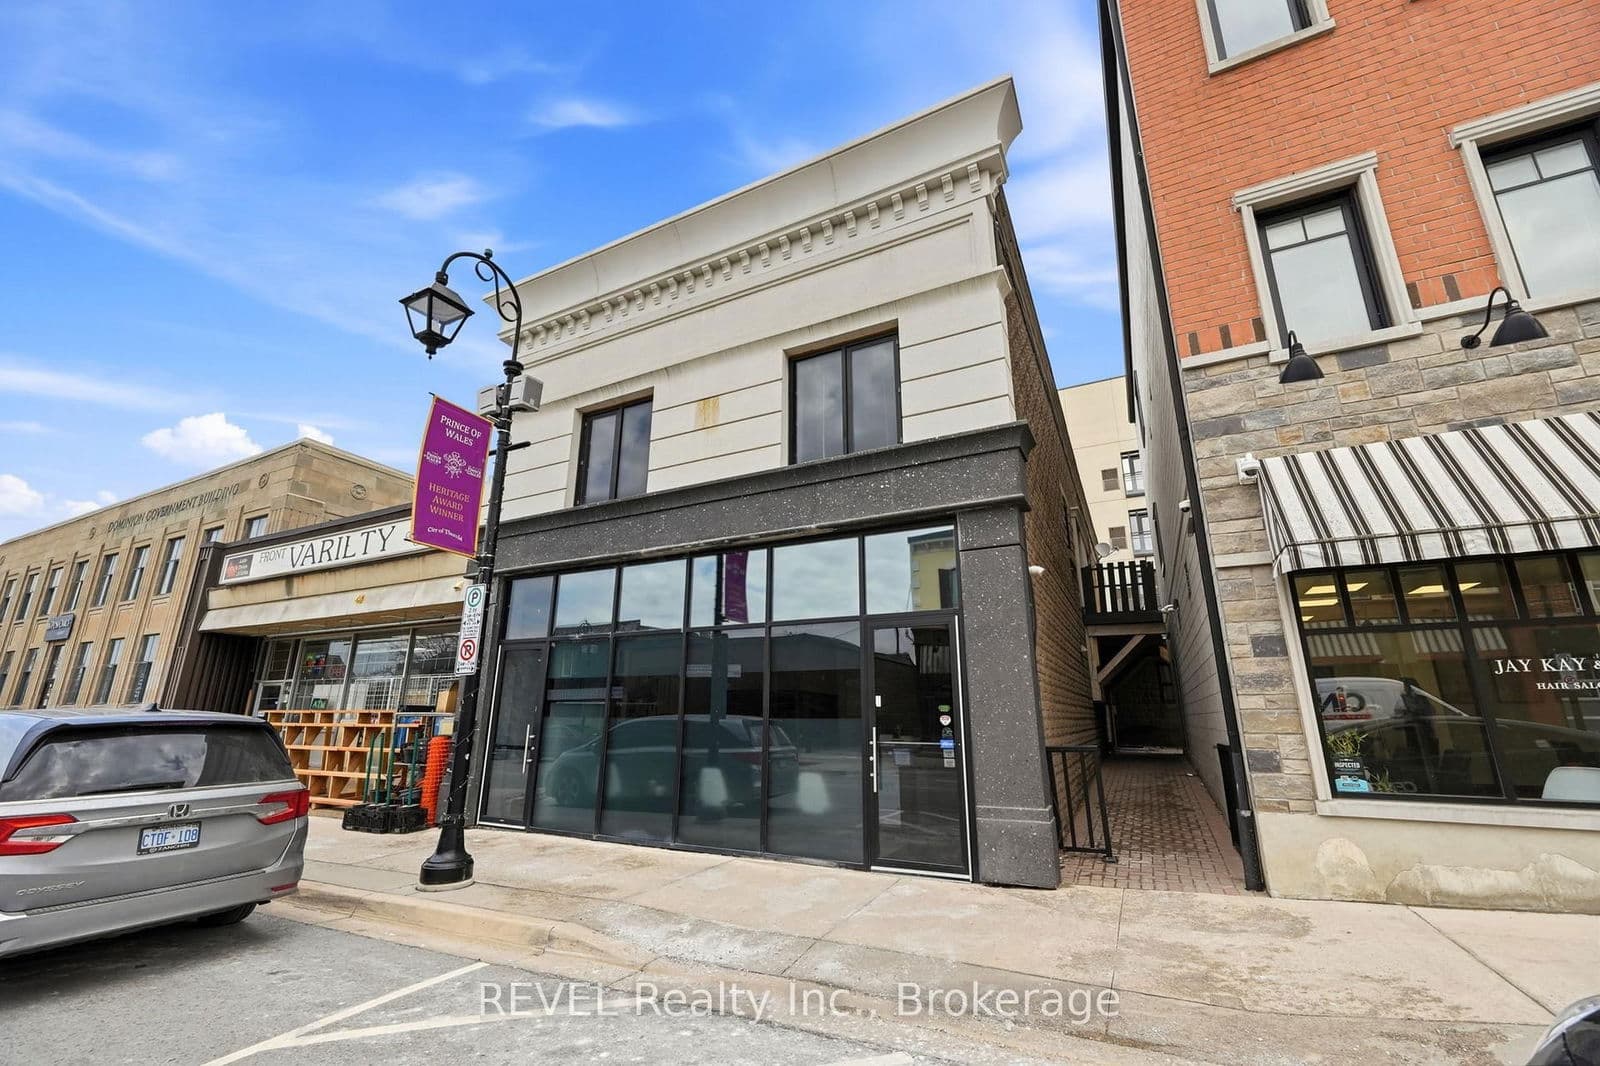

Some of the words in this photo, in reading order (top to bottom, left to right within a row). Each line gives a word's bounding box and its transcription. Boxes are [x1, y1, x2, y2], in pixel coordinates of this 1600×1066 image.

[440, 414, 471, 434] PRINCE
[470, 428, 482, 439] OF
[445, 428, 474, 447] WALES
[429, 482, 470, 503] HERITAGE
[107, 513, 147, 533] DOMINION
[146, 496, 199, 521] GOVERNMENT
[198, 483, 240, 507] BUILDING
[432, 495, 464, 511] AWARD
[430, 504, 464, 522] WINNER
[259, 547, 288, 563] FRONT
[1494, 659, 1532, 675] JAY
[1540, 657, 1587, 672] KAY
[1536, 682, 1569, 690] HAIR
[178, 828, 198, 843] 108
